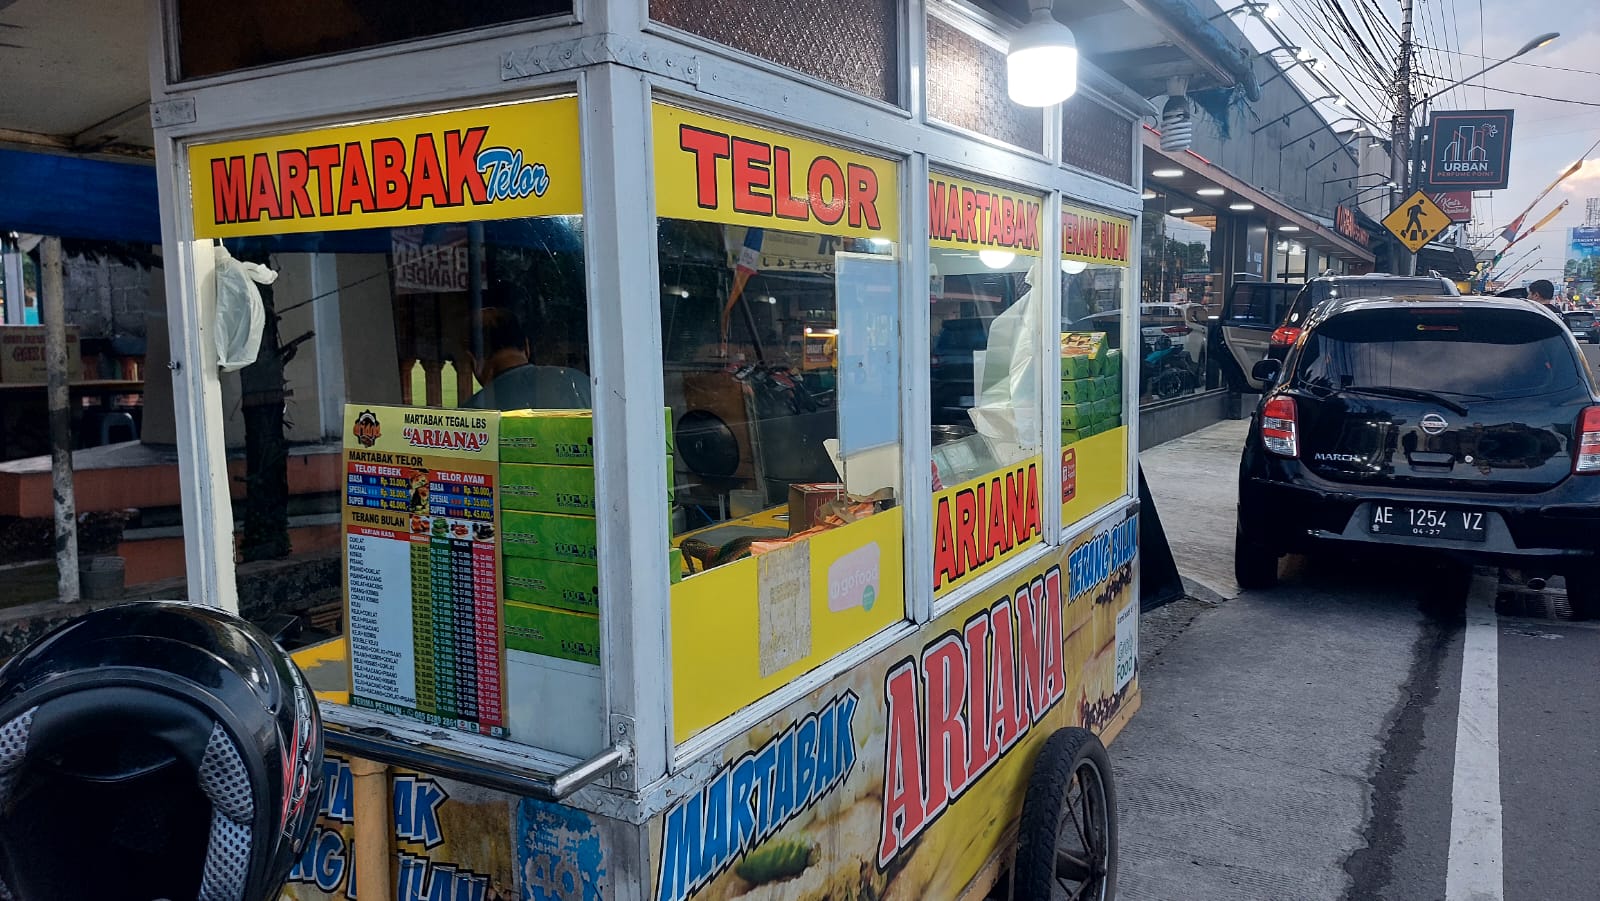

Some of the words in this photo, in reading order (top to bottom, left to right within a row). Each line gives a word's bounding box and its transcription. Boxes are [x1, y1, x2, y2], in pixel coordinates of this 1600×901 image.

[210, 125, 490, 226] MARTABAK
[477, 147, 551, 202] Telor
[679, 123, 881, 230] TELOR
[1444, 163, 1488, 172] URBAN
[929, 179, 1040, 251] MARTABAK
[1062, 211, 1098, 258] TERANG
[1100, 220, 1128, 261] BULAN
[404, 413, 443, 427] MARTABAK
[445, 416, 469, 428] TEGAL
[471, 418, 487, 429] LBS
[349, 451, 393, 464] MARTABAK
[395, 455, 423, 467] TELOR
[355, 464, 376, 474] TELOR
[378, 467, 401, 476] BEBEK
[1315, 452, 1359, 462] MARCH
[436, 471, 461, 482] TELOR
[463, 475, 485, 485] AYAM
[352, 511, 379, 524] TERANG
[381, 515, 405, 528] BULAN
[933, 463, 1041, 592] ARIANA
[1374, 506, 1393, 524] AE
[1409, 508, 1447, 528] 1254
[1462, 512, 1483, 530] VZ
[841, 566, 877, 594] gofood
[1068, 529, 1110, 607] TERANG
[1116, 656, 1133, 684] FOOD
[876, 563, 1066, 875] ARIANA
[656, 688, 859, 901] MARTABAK
